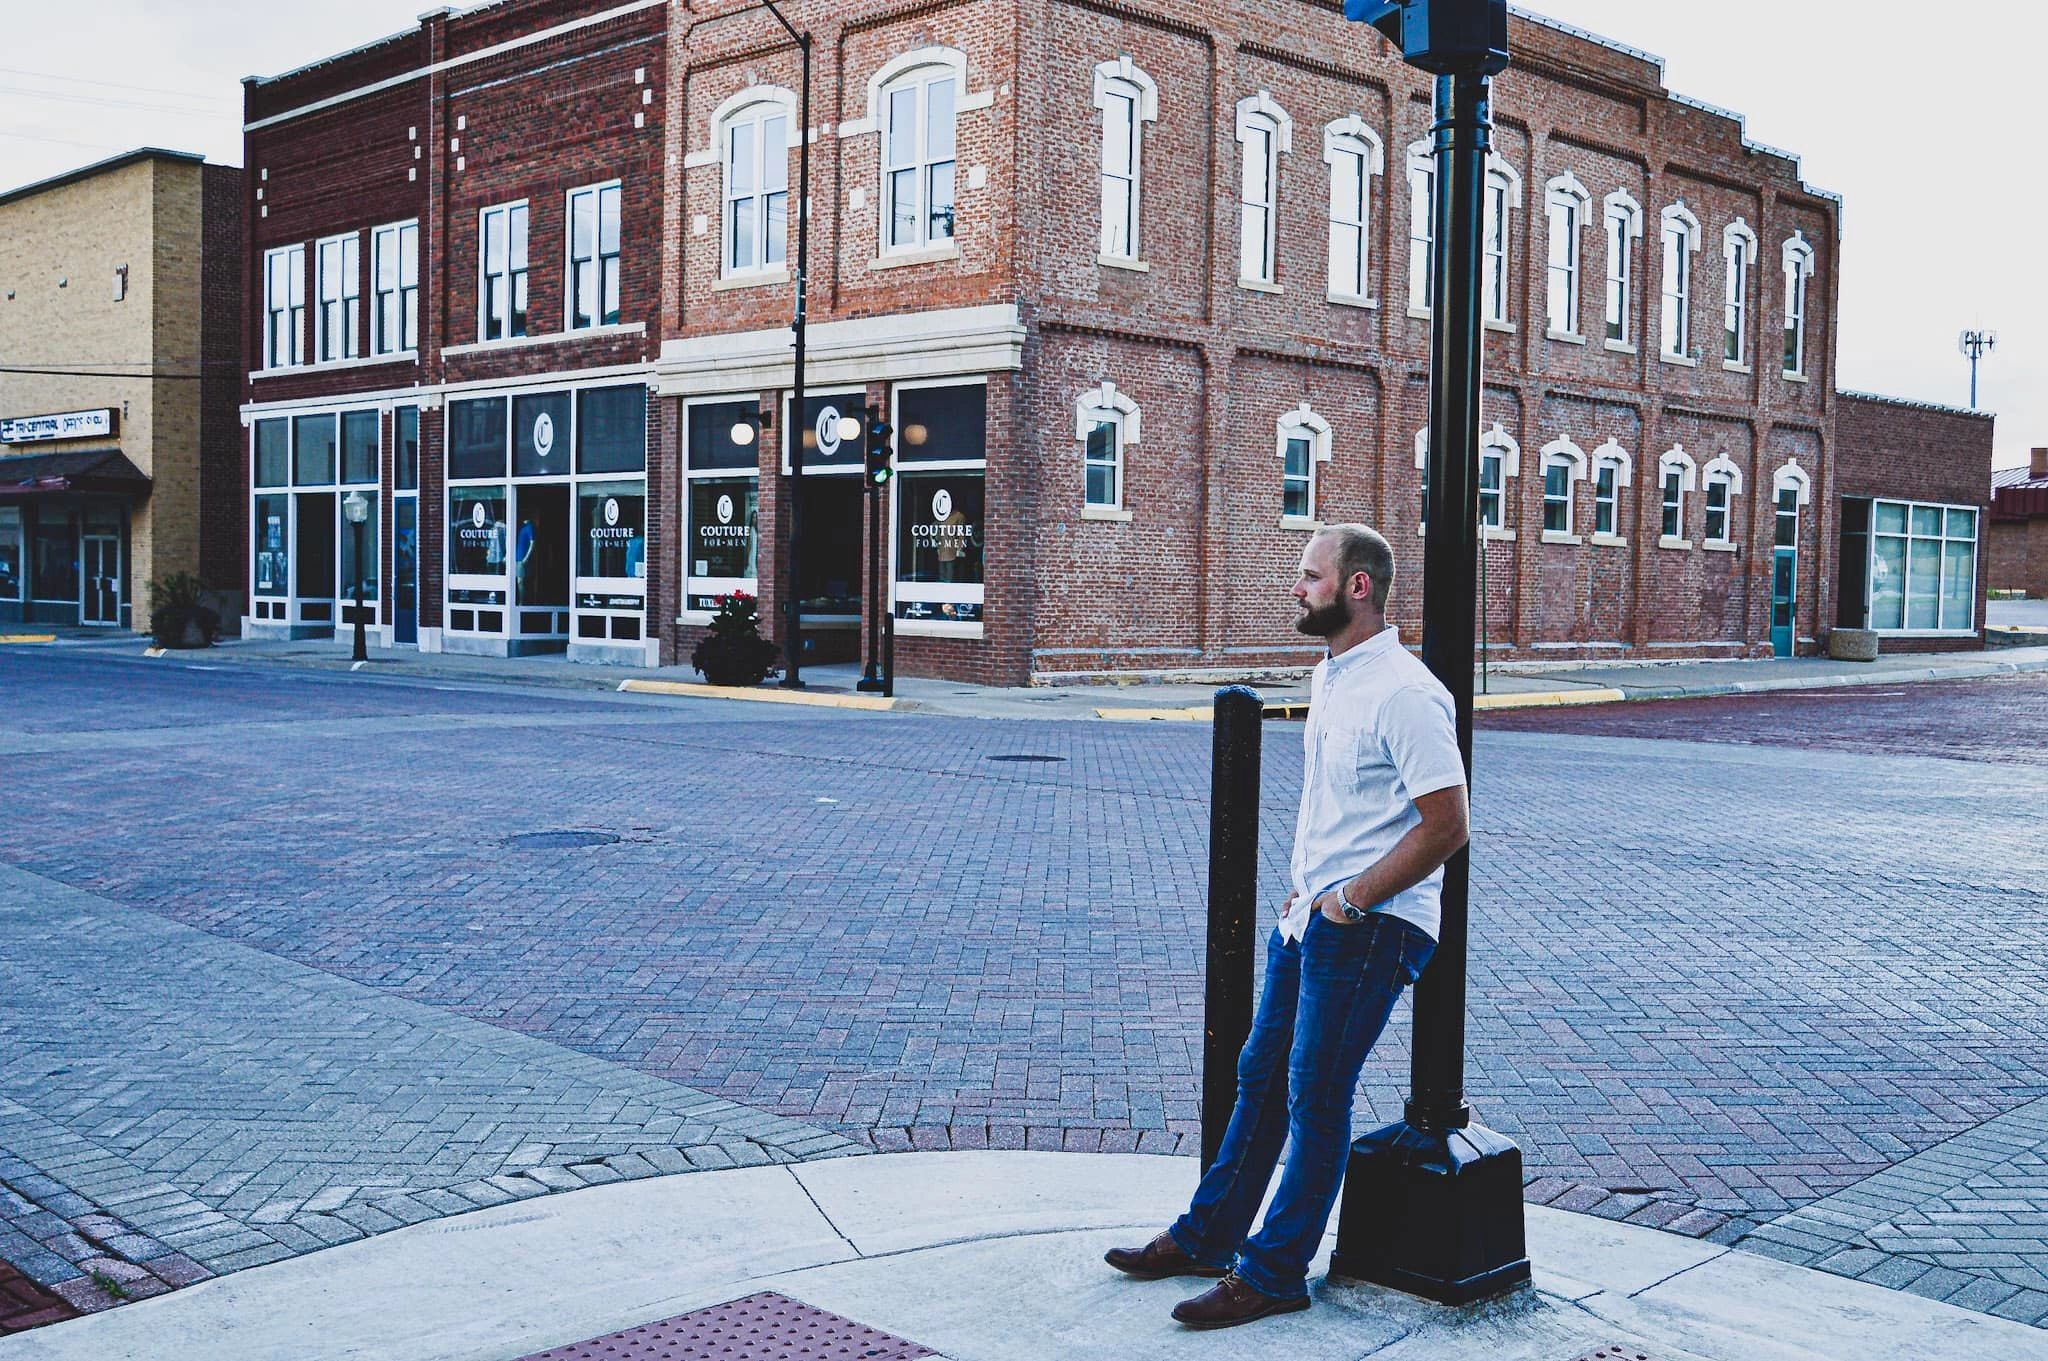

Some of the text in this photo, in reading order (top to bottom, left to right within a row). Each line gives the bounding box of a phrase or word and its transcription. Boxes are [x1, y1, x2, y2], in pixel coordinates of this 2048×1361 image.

[460, 529, 498, 539] COUTURE
[590, 528, 634, 538] COUTURE
[700, 526, 750, 537] COUTURE
[911, 524, 973, 537] COUTURE
